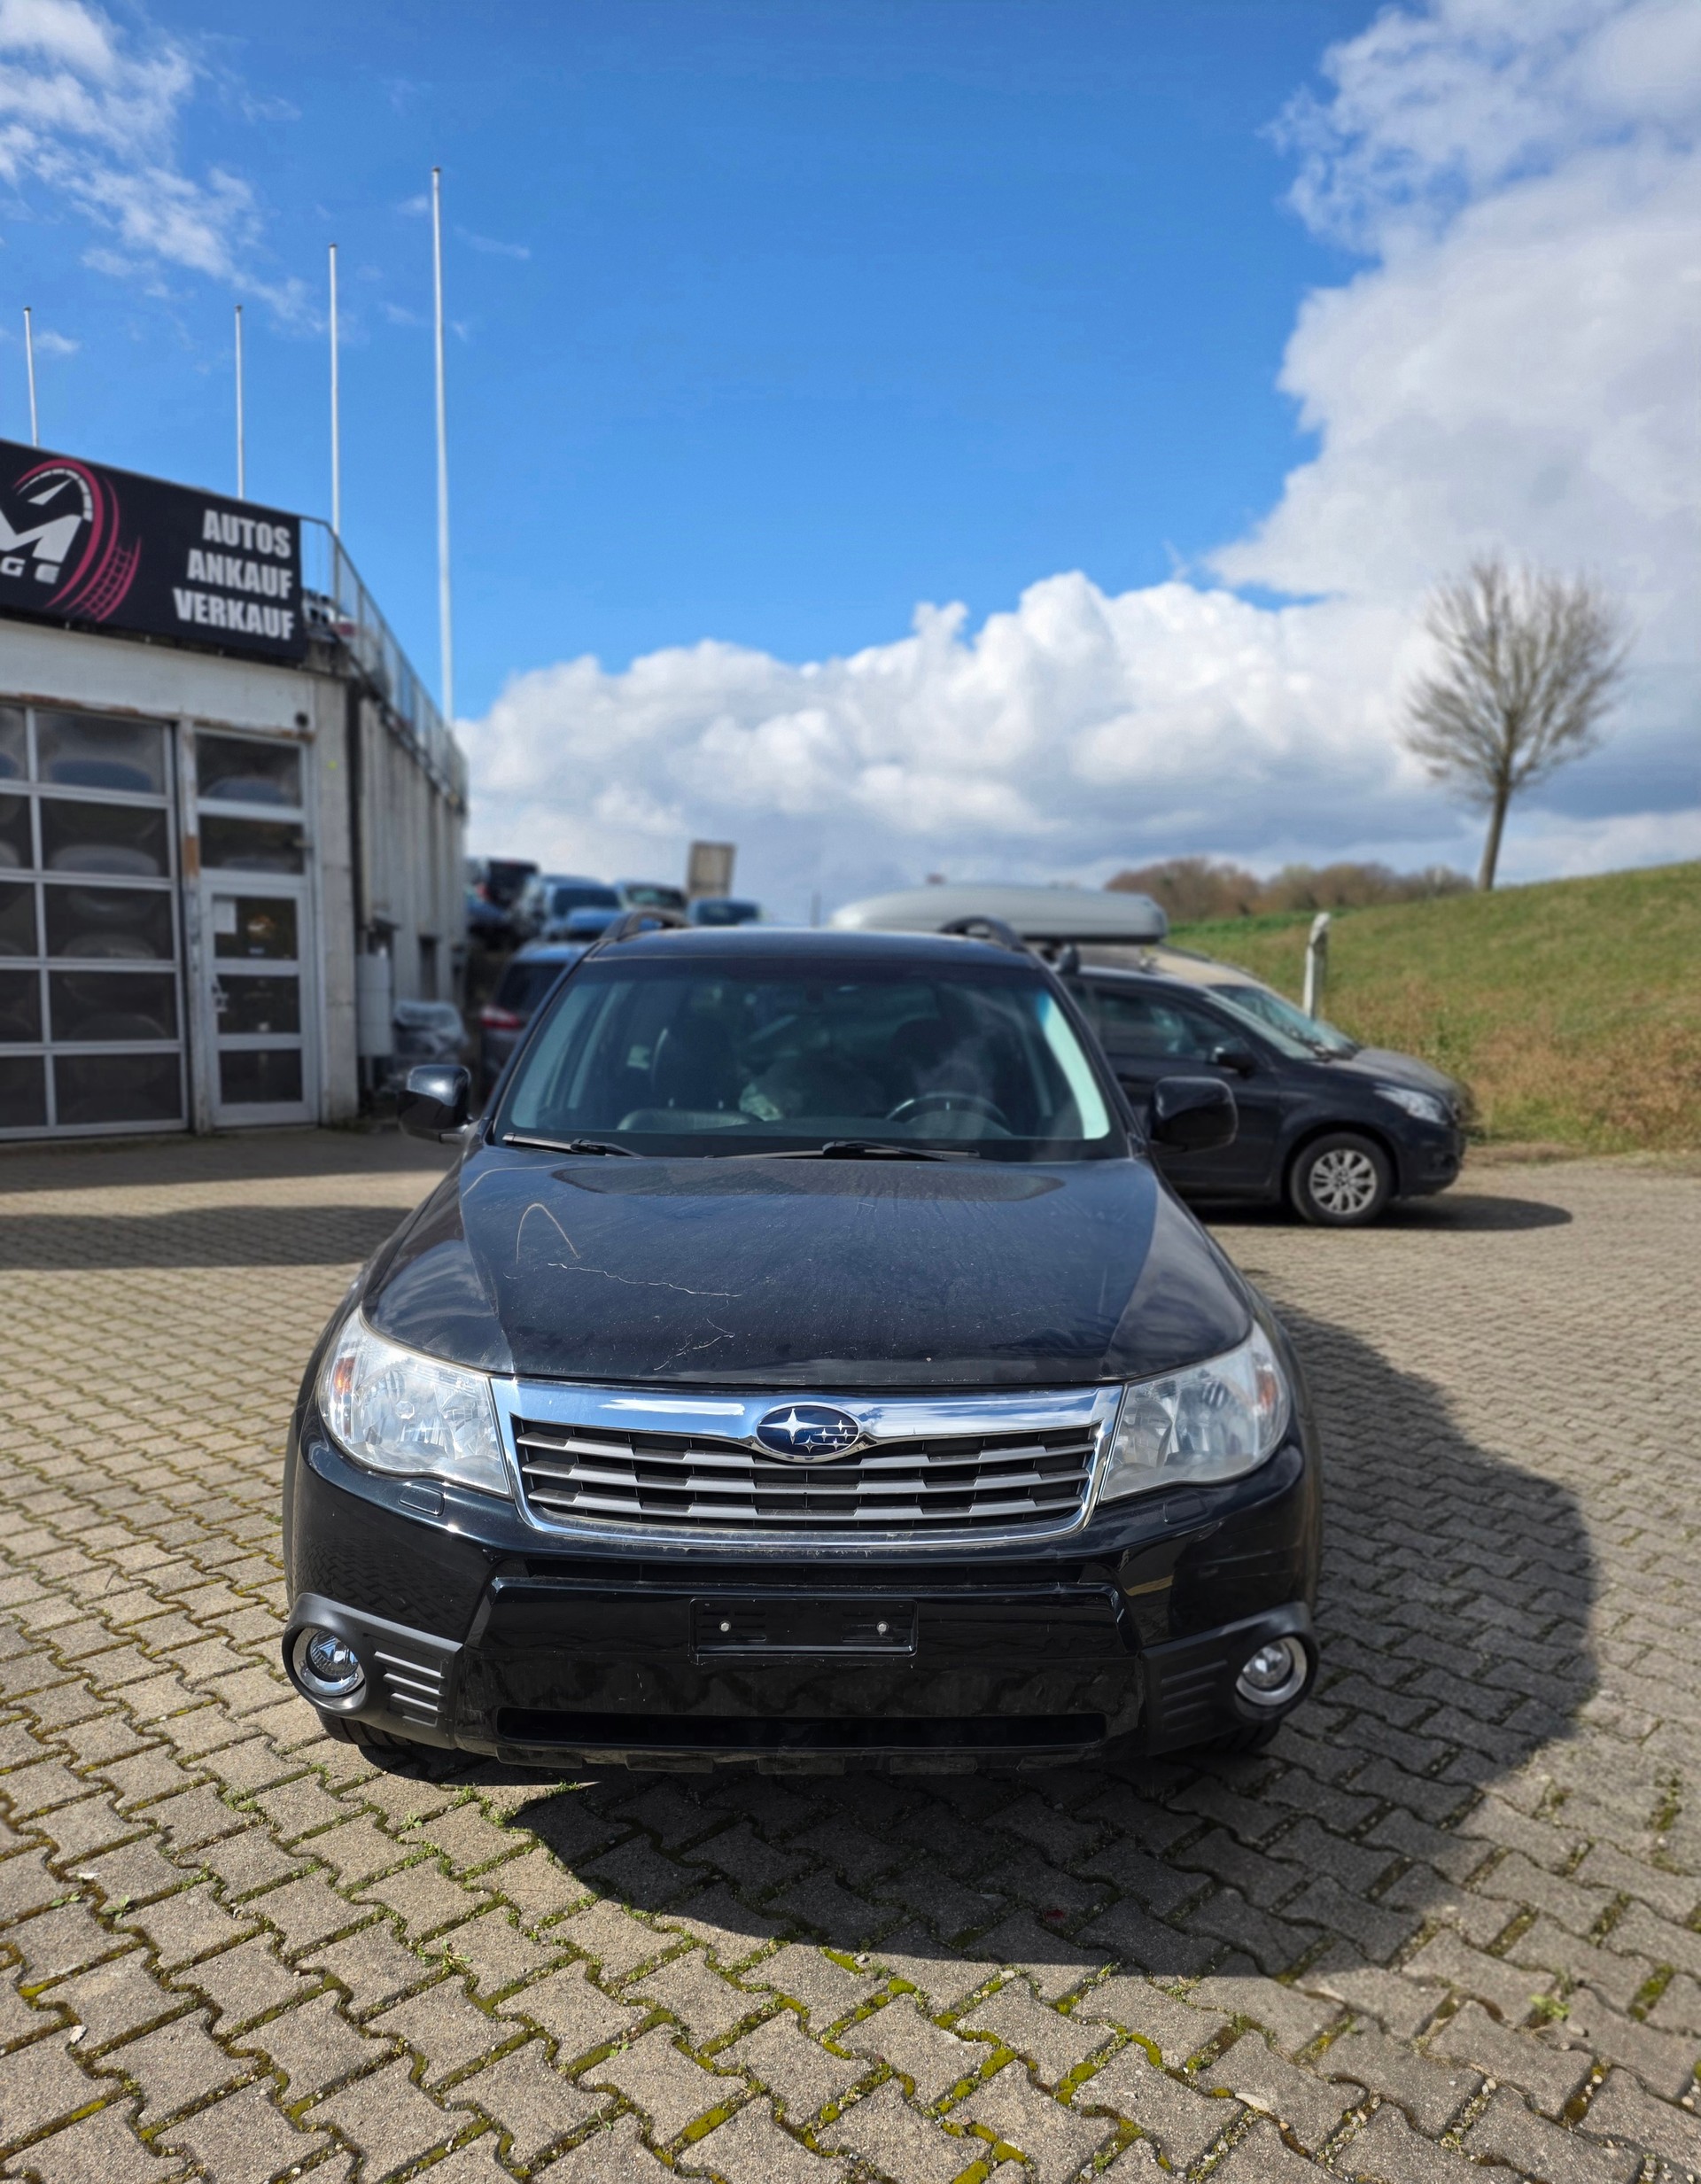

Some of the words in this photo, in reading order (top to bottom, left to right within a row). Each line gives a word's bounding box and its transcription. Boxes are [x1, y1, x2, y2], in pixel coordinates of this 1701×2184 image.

[203, 509, 291, 559] AUTOS
[187, 548, 293, 600] ANKAUF
[173, 587, 295, 641] VERKAUF
